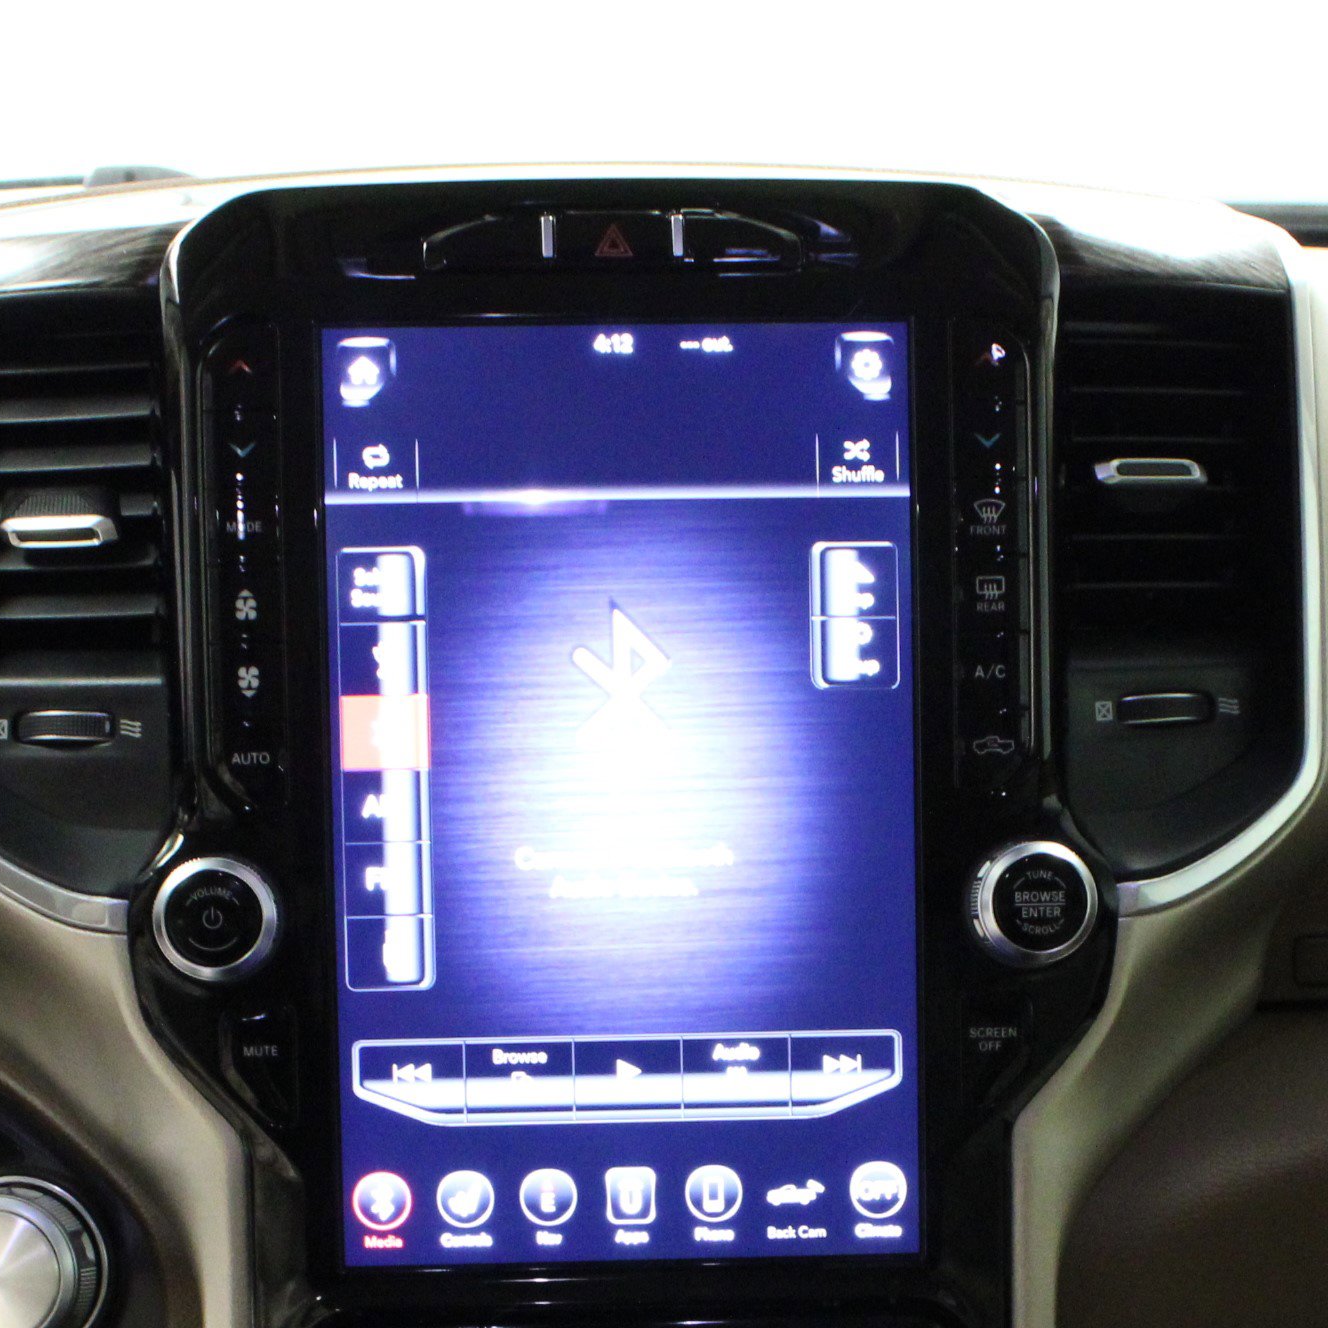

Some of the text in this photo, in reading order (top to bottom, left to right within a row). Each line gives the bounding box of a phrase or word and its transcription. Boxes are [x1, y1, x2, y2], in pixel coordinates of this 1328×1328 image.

[593, 333, 633, 354] 4:12
[832, 465, 885, 482] Shuffle
[348, 472, 403, 492] Repeat
[226, 521, 262, 533] MDE
[970, 525, 1006, 536] FRONT
[976, 602, 1006, 612] REAR
[974, 664, 1006, 679] A/C
[231, 752, 271, 765] AUTO
[1026, 870, 1056, 881] TUNE
[191, 885, 234, 901] VOLUME
[1014, 890, 1066, 903] BROWSE
[1022, 906, 1062, 918] ENTER
[969, 1027, 1018, 1039] SCREEN
[243, 1045, 278, 1057] MUTE
[712, 1042, 760, 1062] Audio
[979, 1041, 1003, 1052] OFF
[492, 1047, 548, 1065] Browse
[364, 1235, 404, 1249] Media
[767, 1226, 797, 1239] Back
[798, 1225, 827, 1239] Cam
